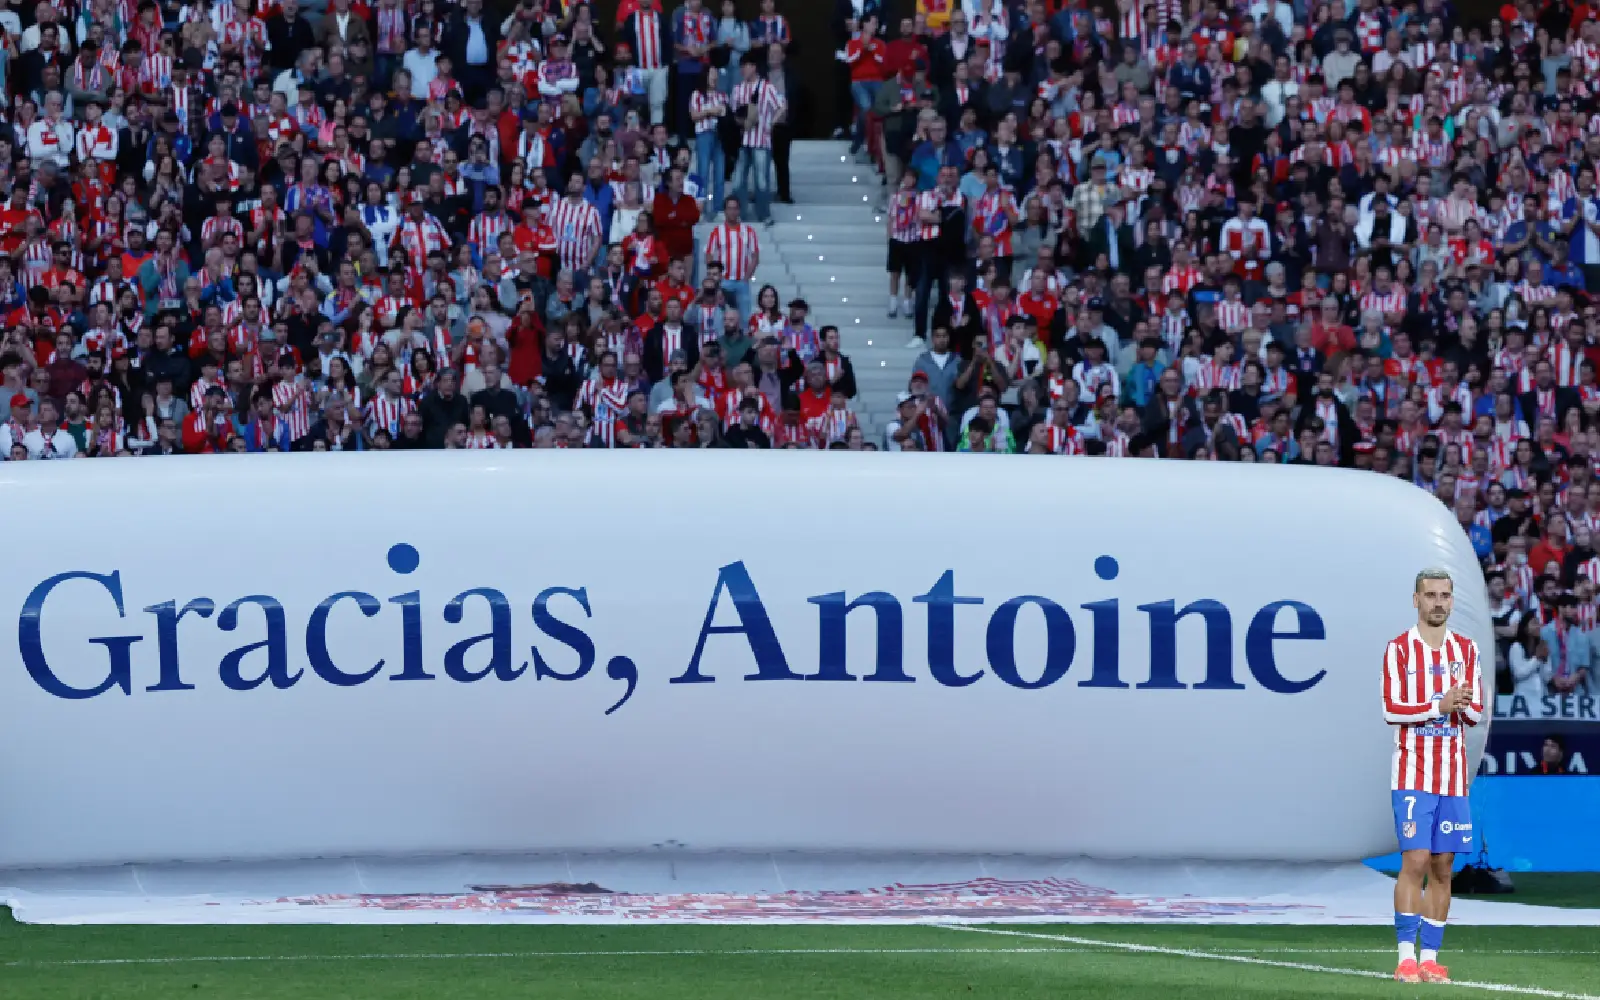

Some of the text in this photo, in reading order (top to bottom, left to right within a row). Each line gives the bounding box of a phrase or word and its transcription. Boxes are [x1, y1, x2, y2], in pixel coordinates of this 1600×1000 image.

[19, 543, 1327, 715] Gracias, Antoine
[1493, 694, 1530, 718] LA
[1404, 796, 1417, 820] 7
